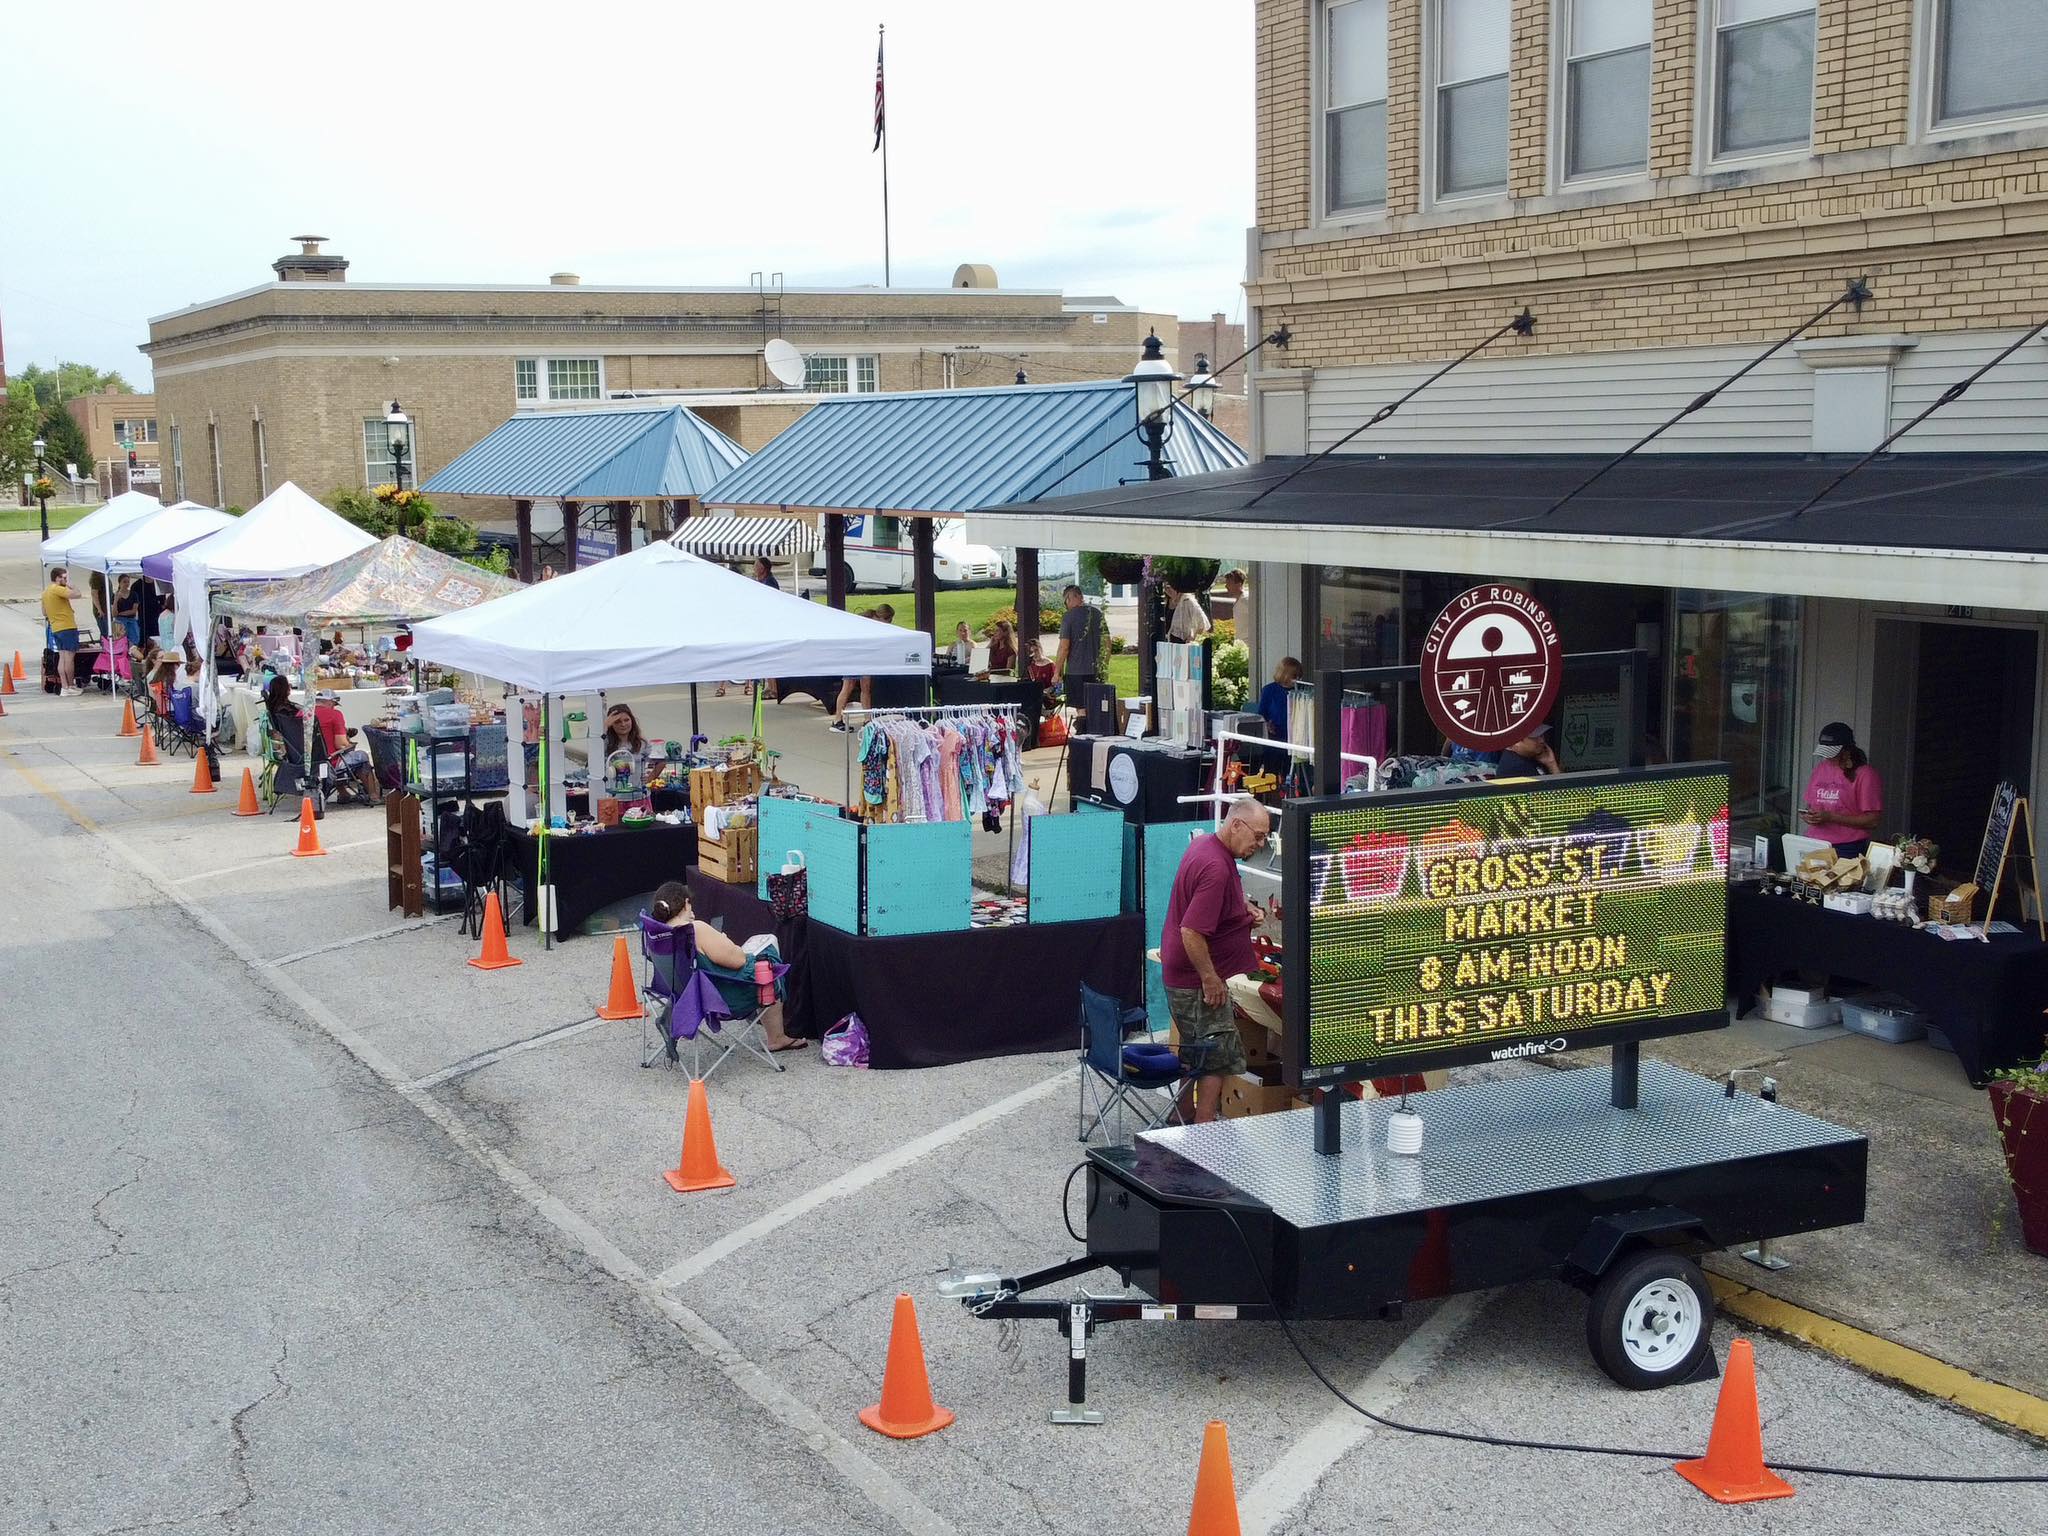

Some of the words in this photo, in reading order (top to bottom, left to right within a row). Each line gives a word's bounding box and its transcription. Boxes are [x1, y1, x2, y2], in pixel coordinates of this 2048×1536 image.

[1426, 611, 1452, 653] CITY
[1460, 591, 1481, 609] OF
[1490, 588, 1557, 646] ROBINSON
[1430, 853, 1551, 898] CROSS
[1562, 845, 1620, 886] ST.
[1445, 892, 1599, 942] MARKET
[1419, 956, 1442, 991] 8
[1369, 1002, 1466, 1044] THIS
[1477, 972, 1673, 1031] SATURDAY
[1491, 1042, 1546, 1060] watchfire
